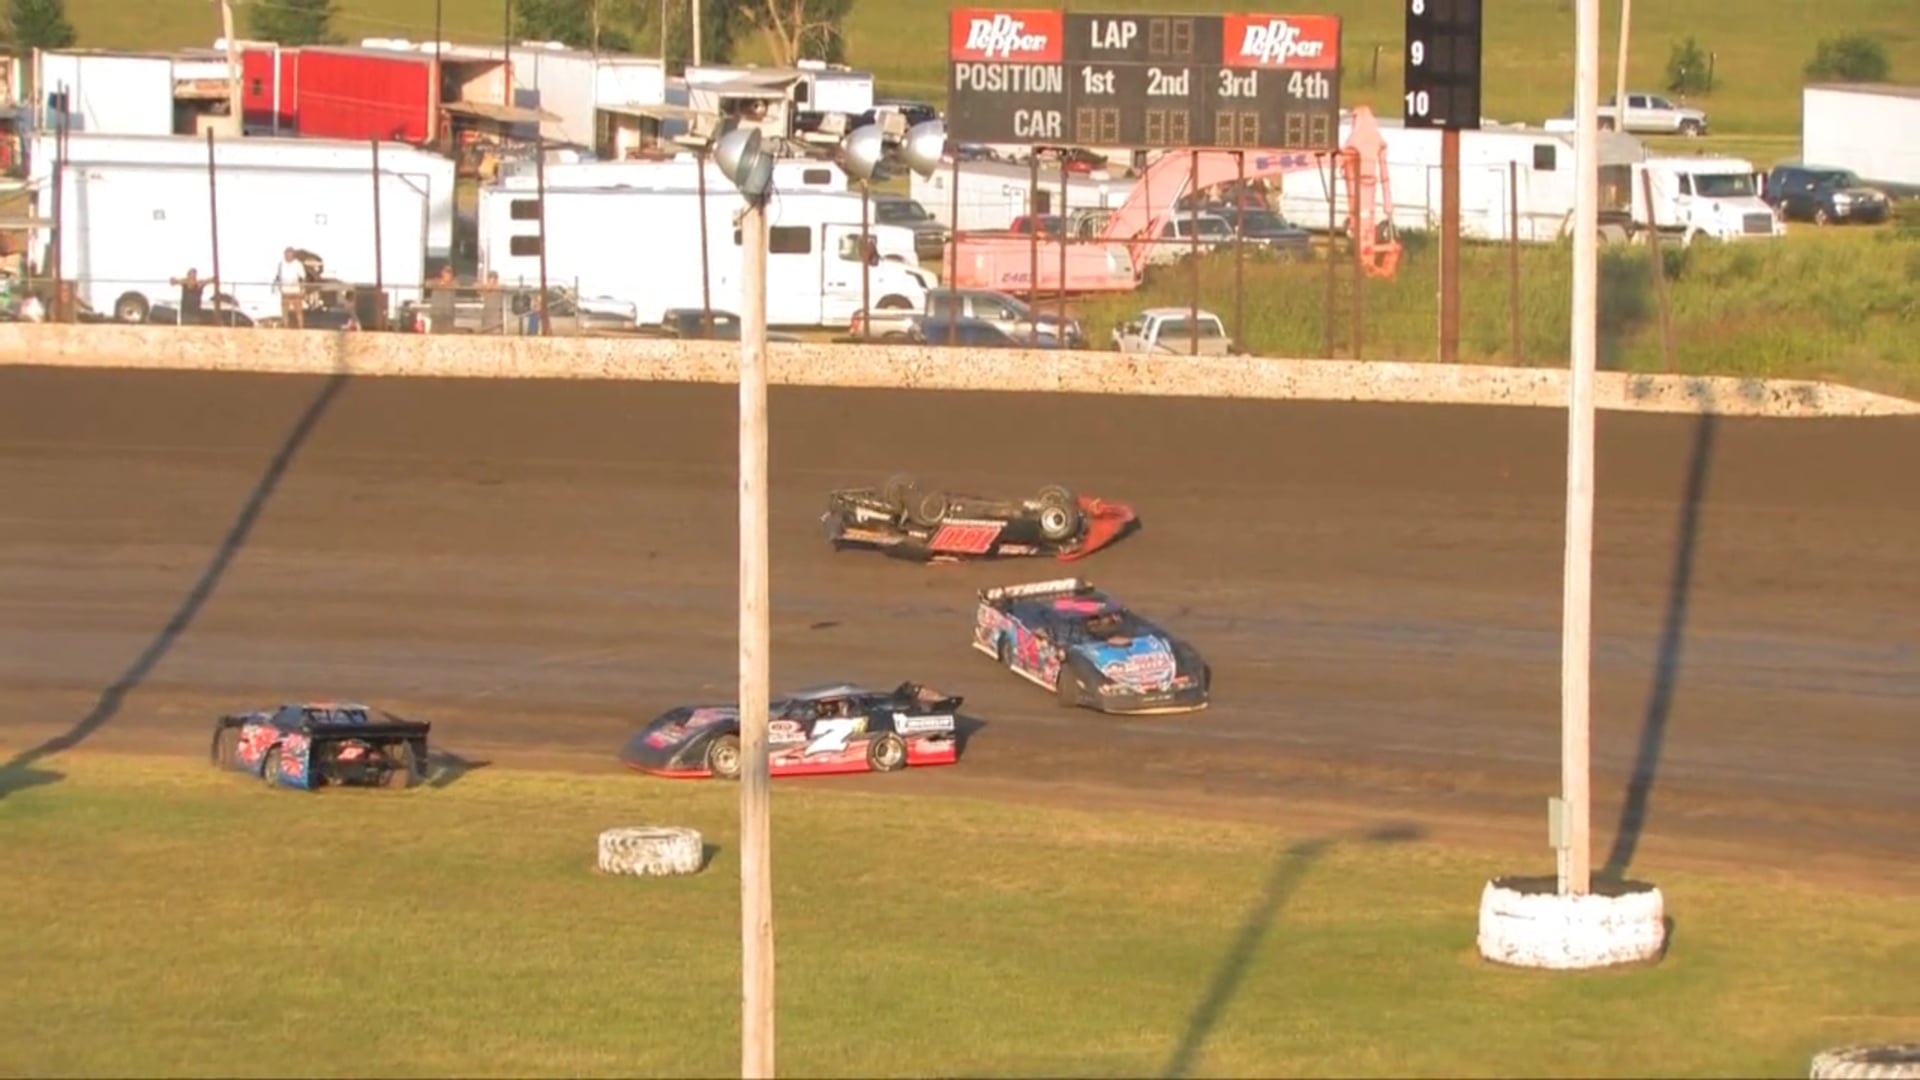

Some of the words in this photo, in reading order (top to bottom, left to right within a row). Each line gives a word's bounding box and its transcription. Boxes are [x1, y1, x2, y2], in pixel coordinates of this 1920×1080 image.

[965, 19, 1048, 57] Pepper
[993, 14, 1025, 40] Dr
[1091, 20, 1138, 49] LAP
[1268, 20, 1301, 45] Dr
[1240, 25, 1324, 64] Pepper
[1411, 40, 1424, 67] 9
[955, 63, 1063, 93] POSITION
[1081, 65, 1116, 94] 1st
[1146, 67, 1190, 95] 2nd
[1218, 69, 1258, 97] 3rd
[1287, 71, 1330, 99] 4th
[1405, 91, 1429, 116] 10
[1014, 109, 1062, 138] CAR
